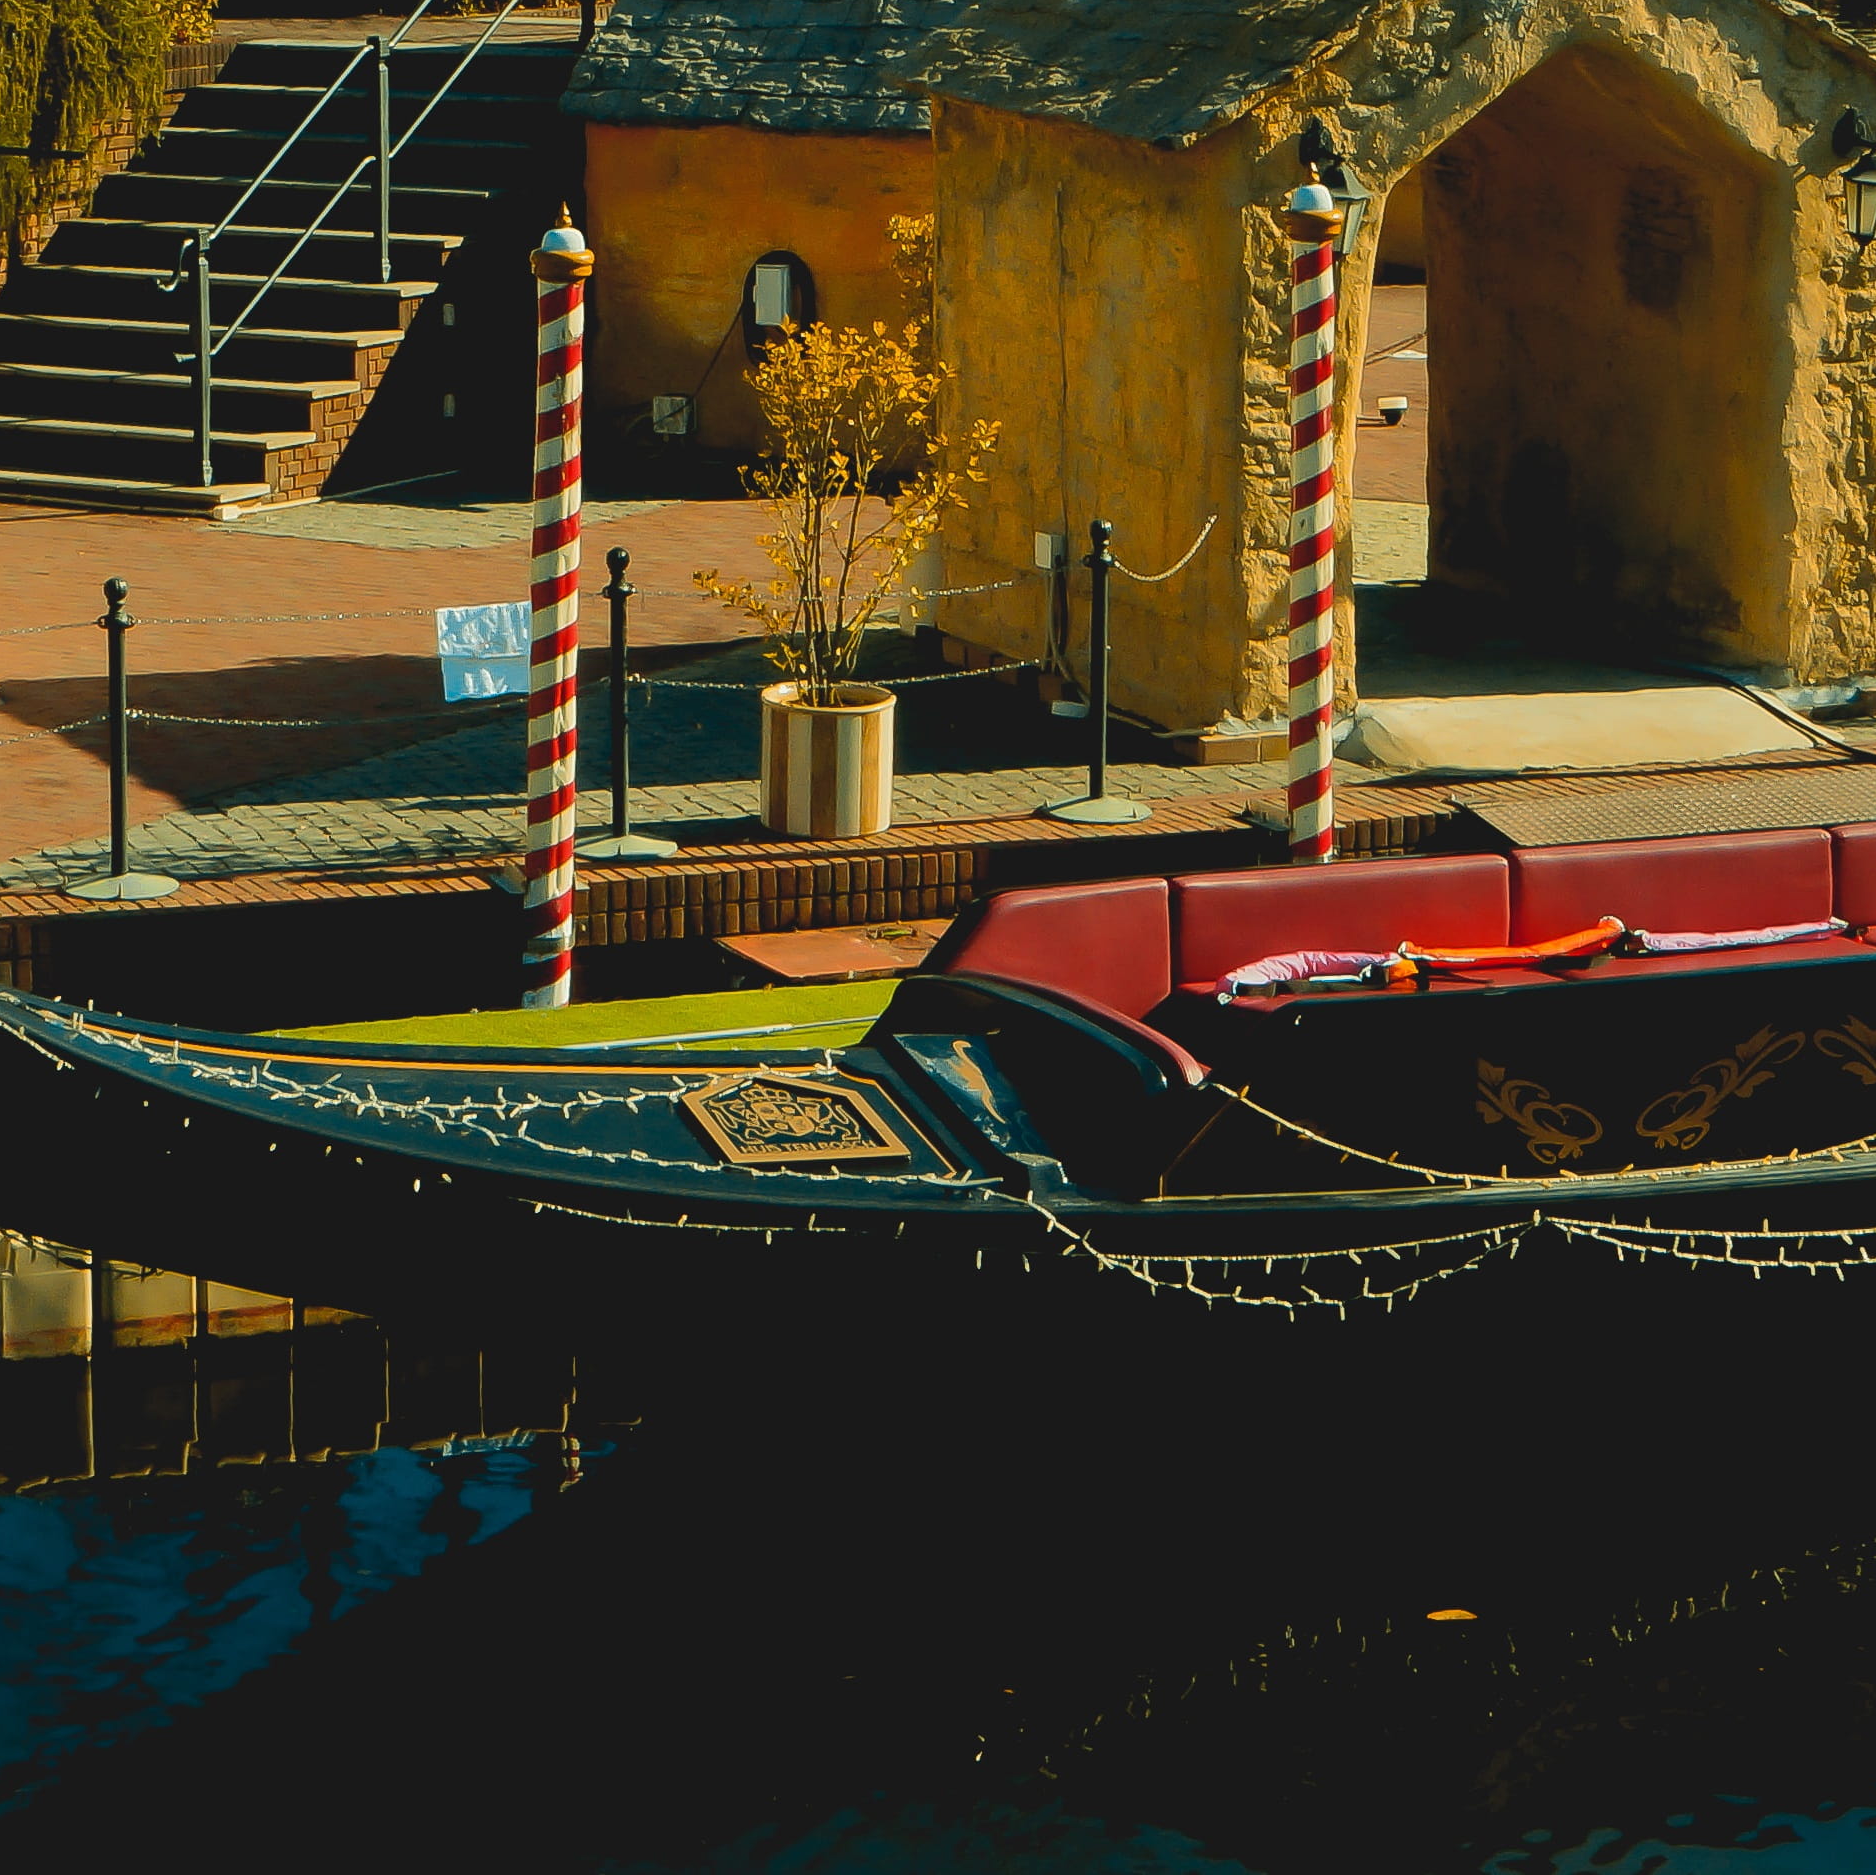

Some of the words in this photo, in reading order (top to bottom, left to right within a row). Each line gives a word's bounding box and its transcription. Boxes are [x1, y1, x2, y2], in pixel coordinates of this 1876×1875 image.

[739, 1142, 780, 1154] HUIS
[782, 1141, 817, 1152] TEN
[818, 1139, 877, 1151] BOSCH
